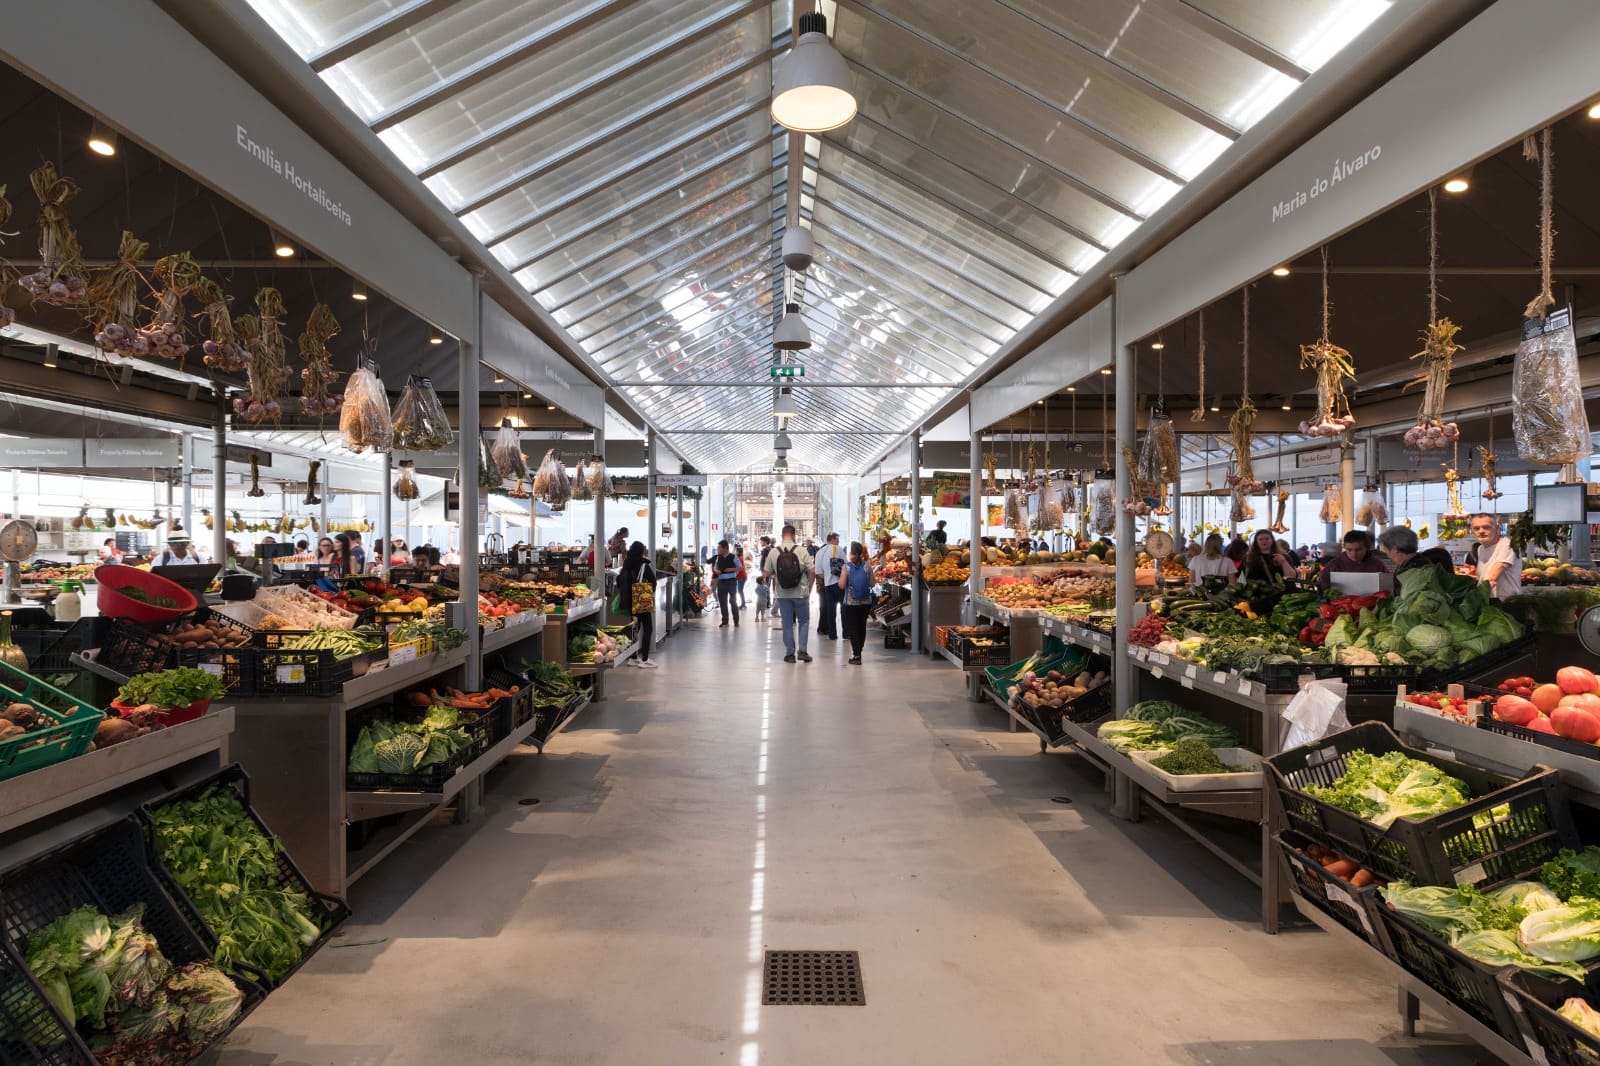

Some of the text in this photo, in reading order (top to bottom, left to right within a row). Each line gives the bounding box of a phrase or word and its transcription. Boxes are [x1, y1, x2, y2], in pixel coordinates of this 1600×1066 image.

[285, 161, 352, 226] Hortaliceira
[1272, 145, 1381, 223] Maria do Álvaro
